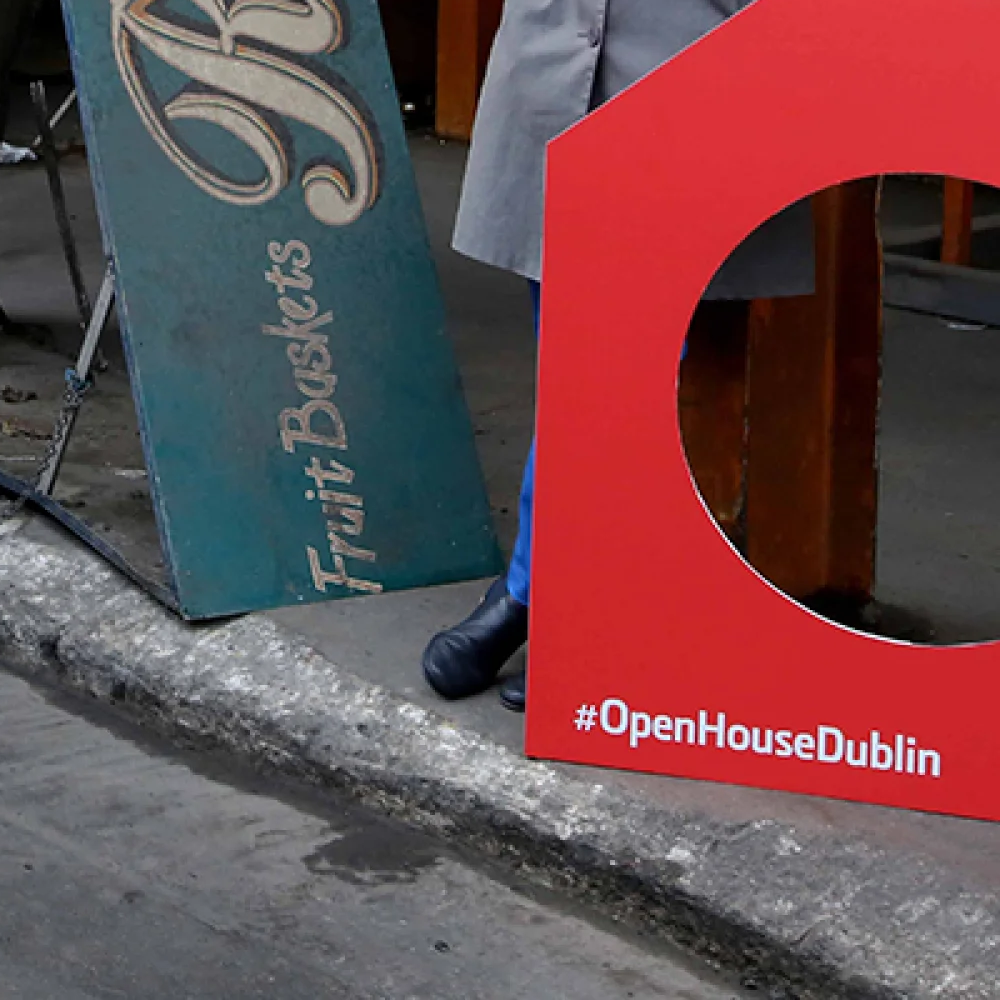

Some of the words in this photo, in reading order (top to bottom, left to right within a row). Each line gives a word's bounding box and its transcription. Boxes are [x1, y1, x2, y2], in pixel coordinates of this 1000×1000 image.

[261, 239, 349, 453] Baskets
[305, 456, 384, 593] Fruit
[573, 697, 942, 778] #OpenHouseDublin
